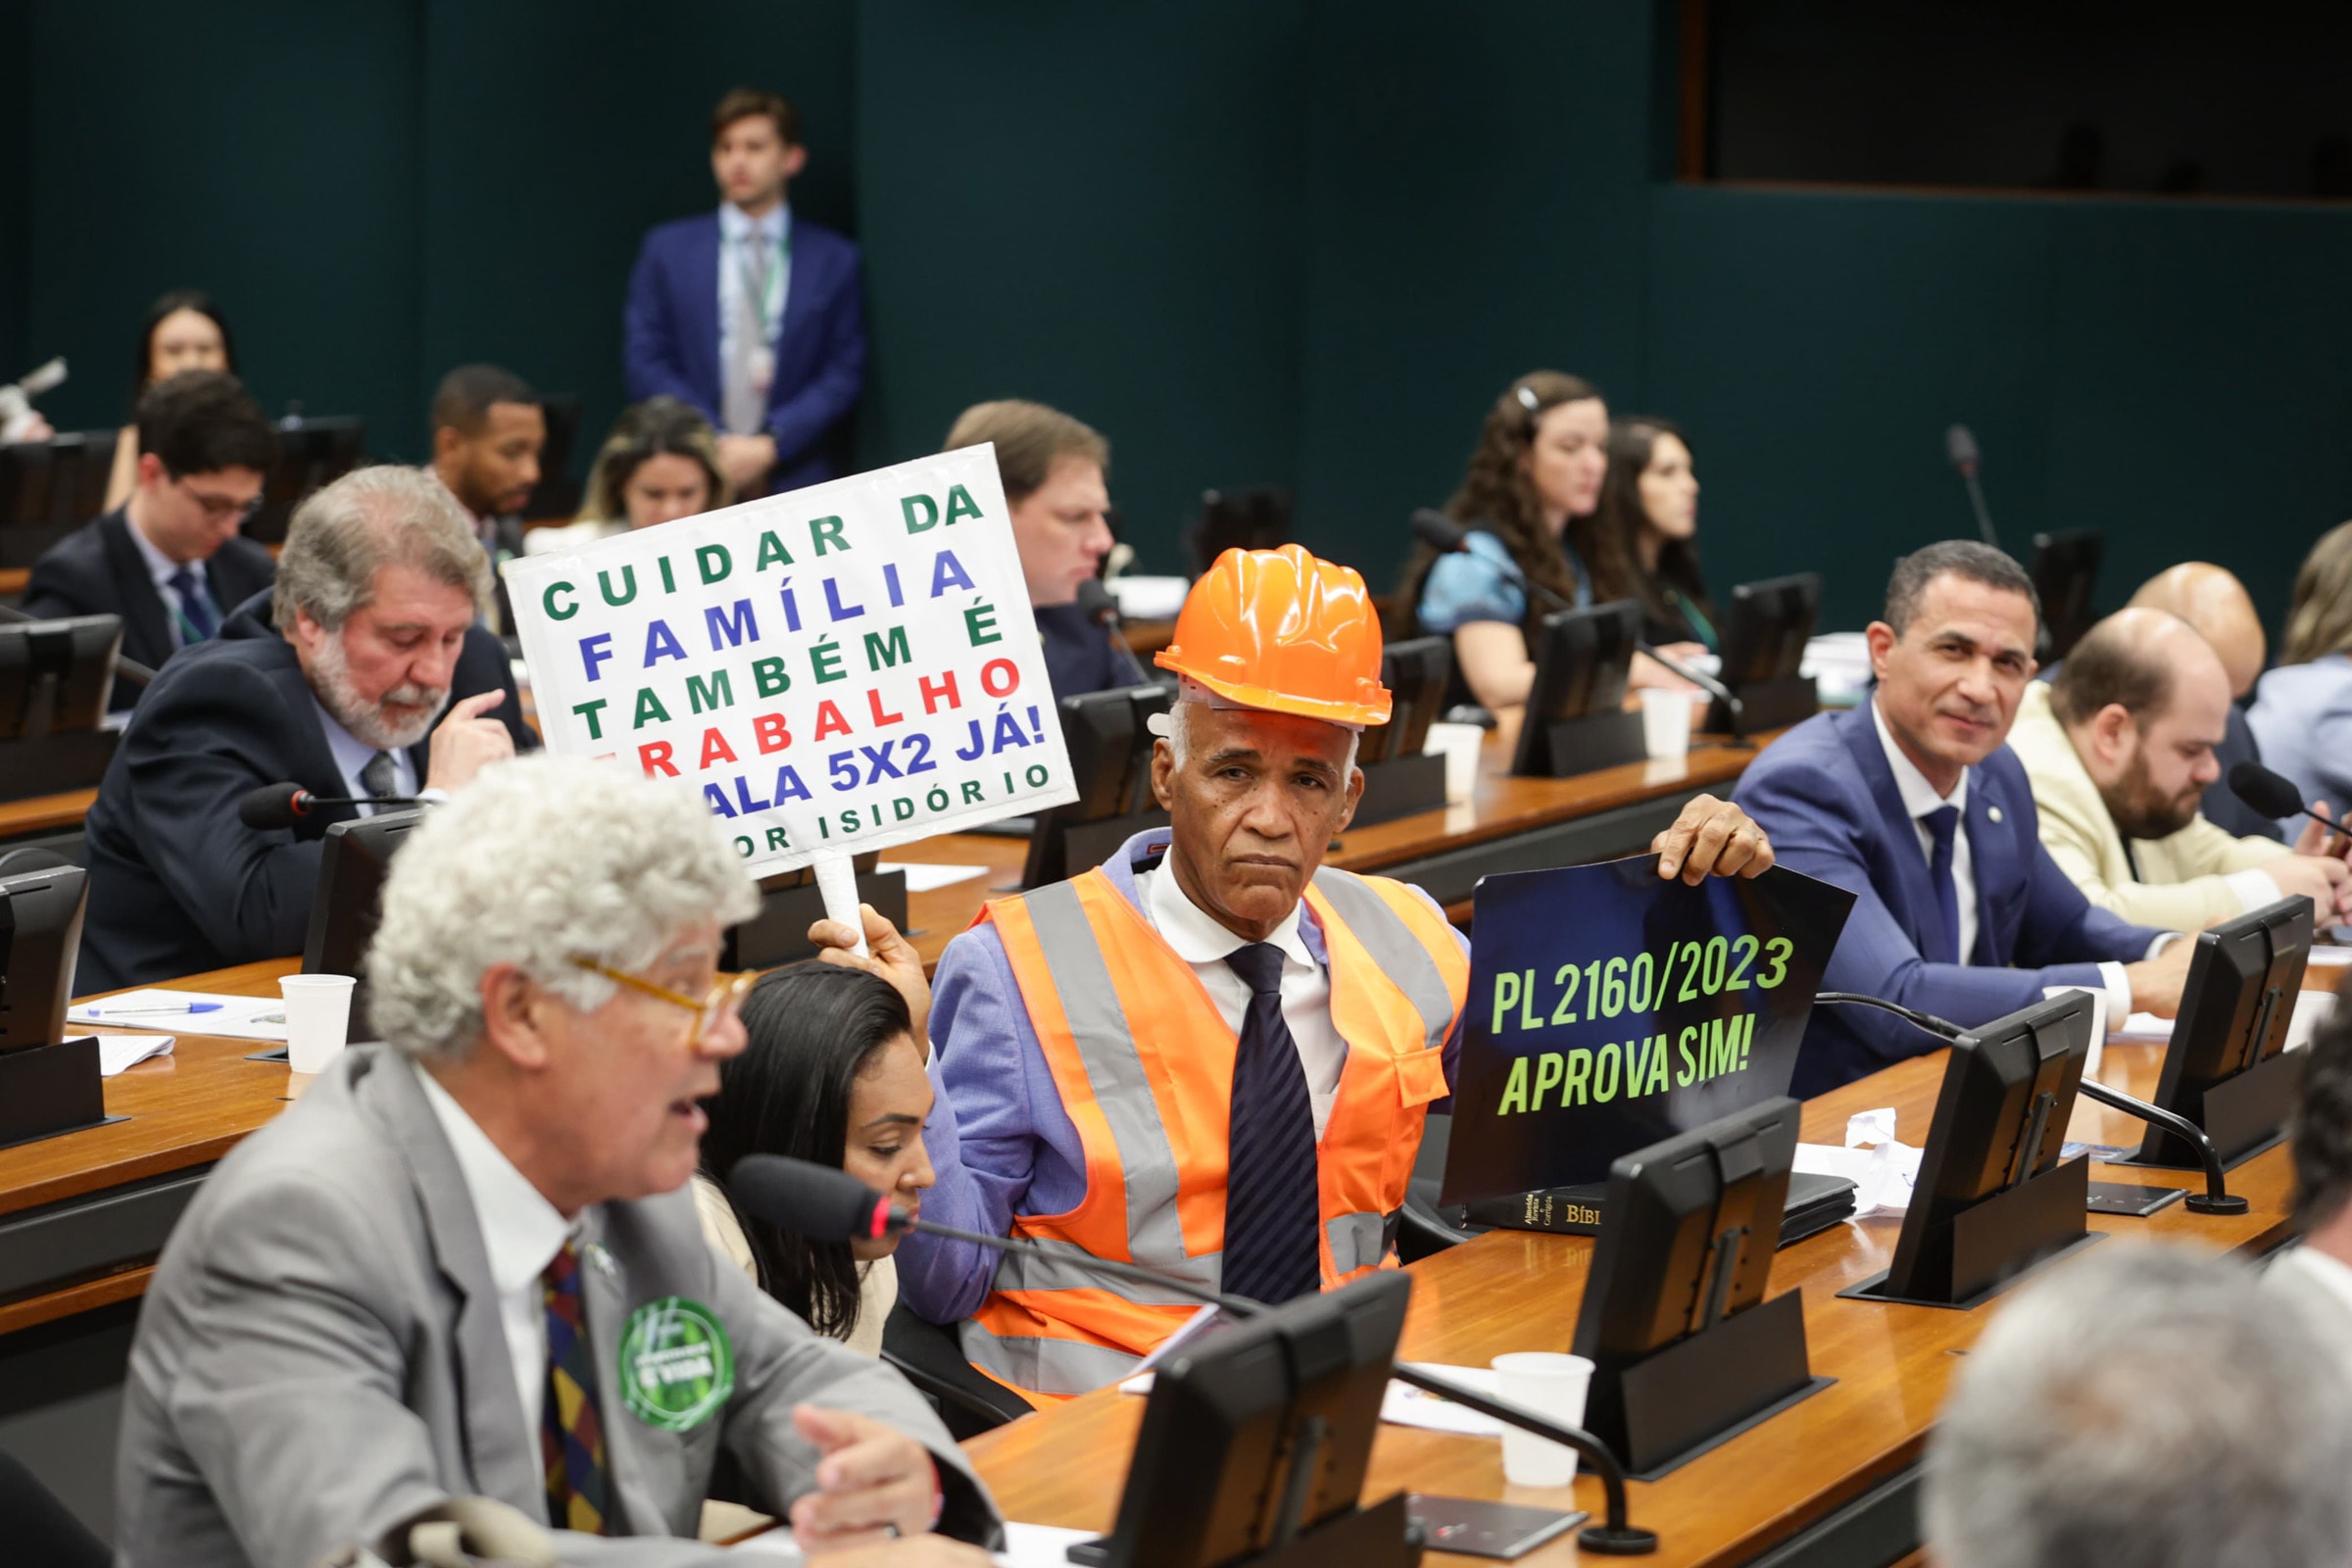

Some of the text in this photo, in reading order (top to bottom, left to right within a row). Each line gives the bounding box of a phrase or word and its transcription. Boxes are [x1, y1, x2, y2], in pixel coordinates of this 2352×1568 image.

[543, 483, 984, 621] CUIDAR DA
[572, 596, 1002, 740] TAMBÉM É
[578, 549, 975, 682] FAMÍLIA
[592, 658, 1021, 780] RABALHO
[704, 704, 1047, 819] ALA 5X2 JÁ!
[734, 763, 1051, 858] OR ISIDÓRIO
[1491, 934, 1794, 1035] PL 2160/2023
[1496, 1012, 1757, 1116] APROVA SIM!
